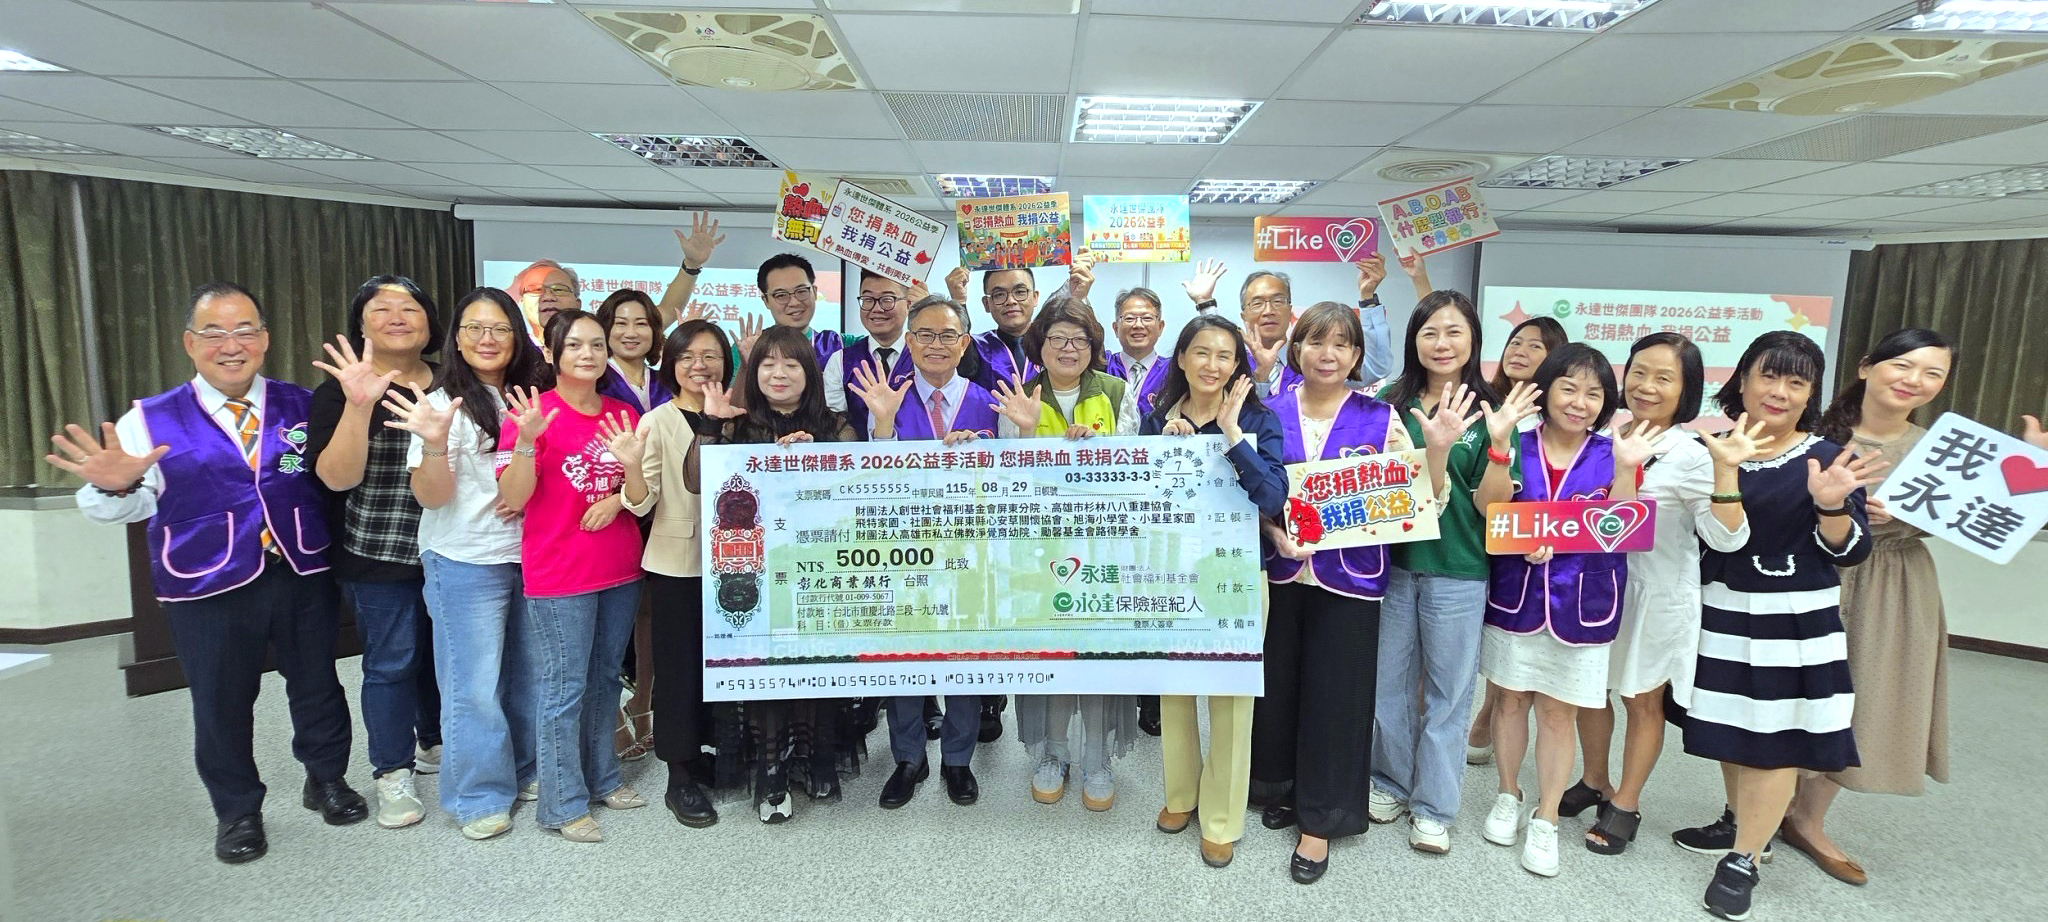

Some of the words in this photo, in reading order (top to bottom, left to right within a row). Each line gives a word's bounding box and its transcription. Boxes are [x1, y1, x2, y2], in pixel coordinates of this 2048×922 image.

[848, 206, 918, 248] 您捐熱血
[895, 210, 939, 234] 2026公益季
[972, 214, 1014, 229] 您捐熱血
[1017, 211, 1060, 226] 我捐公益
[1110, 216, 1166, 228] 2026公益季
[1397, 202, 1480, 238] 什麼型都行
[841, 225, 912, 266] 我捐公益
[1257, 227, 1323, 250] #Like
[1575, 302, 1658, 318] 永達世傑團隊
[1661, 306, 1763, 321] 2026公益季活動
[746, 454, 855, 473] 永達世傑體系
[861, 451, 994, 471] 2026公益季活動
[1000, 450, 1071, 468] 您捐熱血
[1076, 448, 1149, 466] 我捐公益
[1925, 428, 1998, 480] 我
[1175, 460, 1181, 471] 7
[1065, 471, 1151, 483] 03-33333-3-3
[1172, 477, 1185, 488] 23
[1302, 460, 1410, 503] 您捐熱血
[795, 489, 831, 502] 支票號碼
[840, 483, 910, 494] CK5555555
[912, 488, 944, 498] 中華民國
[946, 483, 967, 494] 115
[981, 481, 998, 493] 08
[1001, 487, 1009, 497] 月
[1012, 481, 1028, 492] 29
[1320, 489, 1413, 532] 我捐公益
[1889, 473, 2026, 550] 永達
[774, 518, 786, 530] 支
[1490, 513, 1580, 538] #Like
[796, 529, 850, 544] 憑票請付
[797, 561, 824, 573] NT$
[837, 548, 934, 570] 500,000
[945, 558, 969, 570] 此致
[775, 572, 788, 585] 票
[797, 575, 892, 590] 彰化商業銀行
[904, 574, 928, 587] 台照
[1081, 564, 1119, 584] 永達
[1121, 573, 1199, 584] 社會福利基金會
[801, 593, 843, 603] 付款行代號
[845, 593, 889, 601] 01-009-5067
[1116, 595, 1203, 613] 保險經紀人
[853, 619, 893, 627] 支票存款
